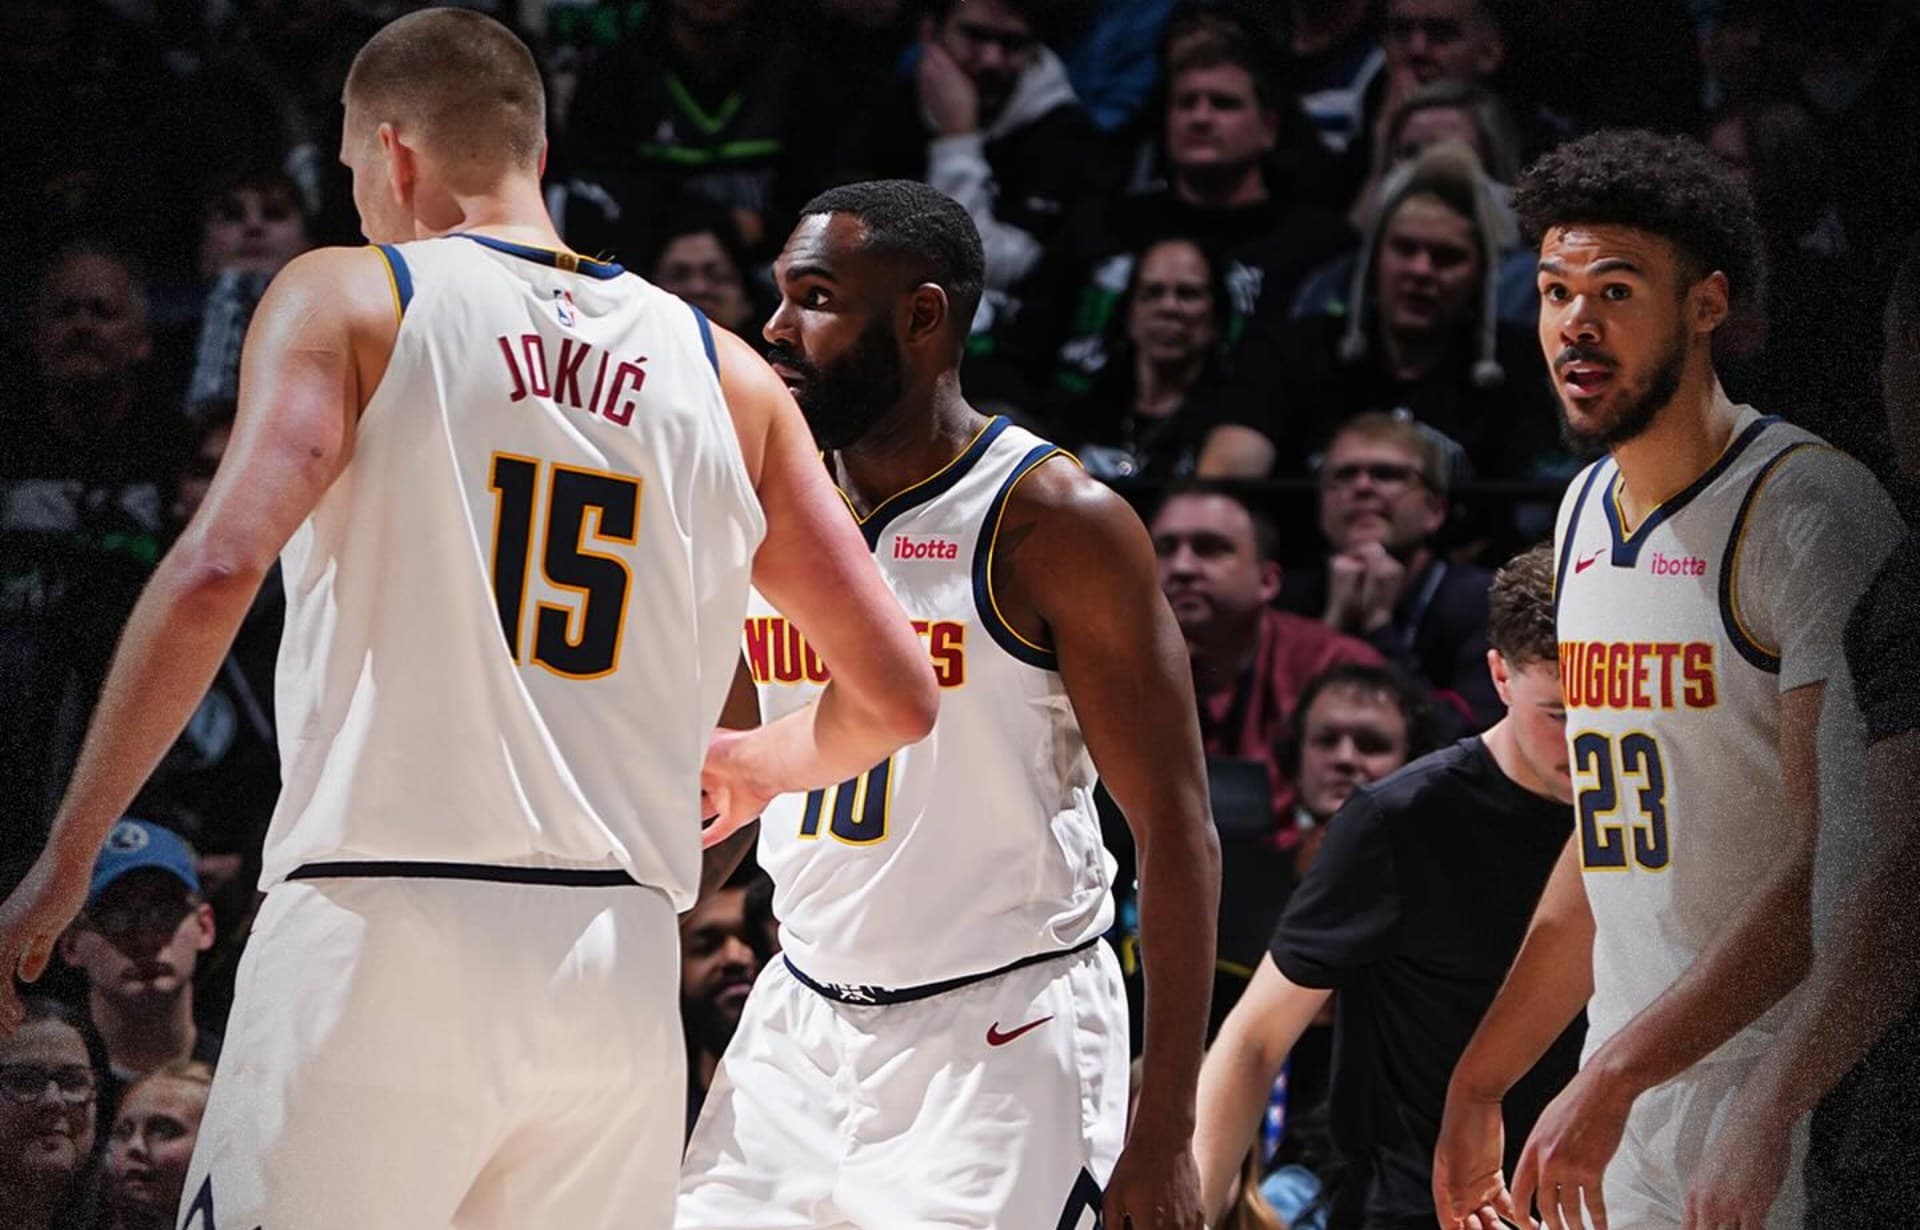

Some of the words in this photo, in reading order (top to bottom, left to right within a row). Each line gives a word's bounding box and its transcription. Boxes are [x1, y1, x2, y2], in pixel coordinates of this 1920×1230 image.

[498, 334, 648, 427] JOKIĆ
[488, 451, 642, 680] 15
[893, 535, 959, 560] ibotta
[1651, 552, 1707, 576] ibotta
[1559, 641, 1718, 711] NUGGETS
[1573, 730, 1673, 873] 23
